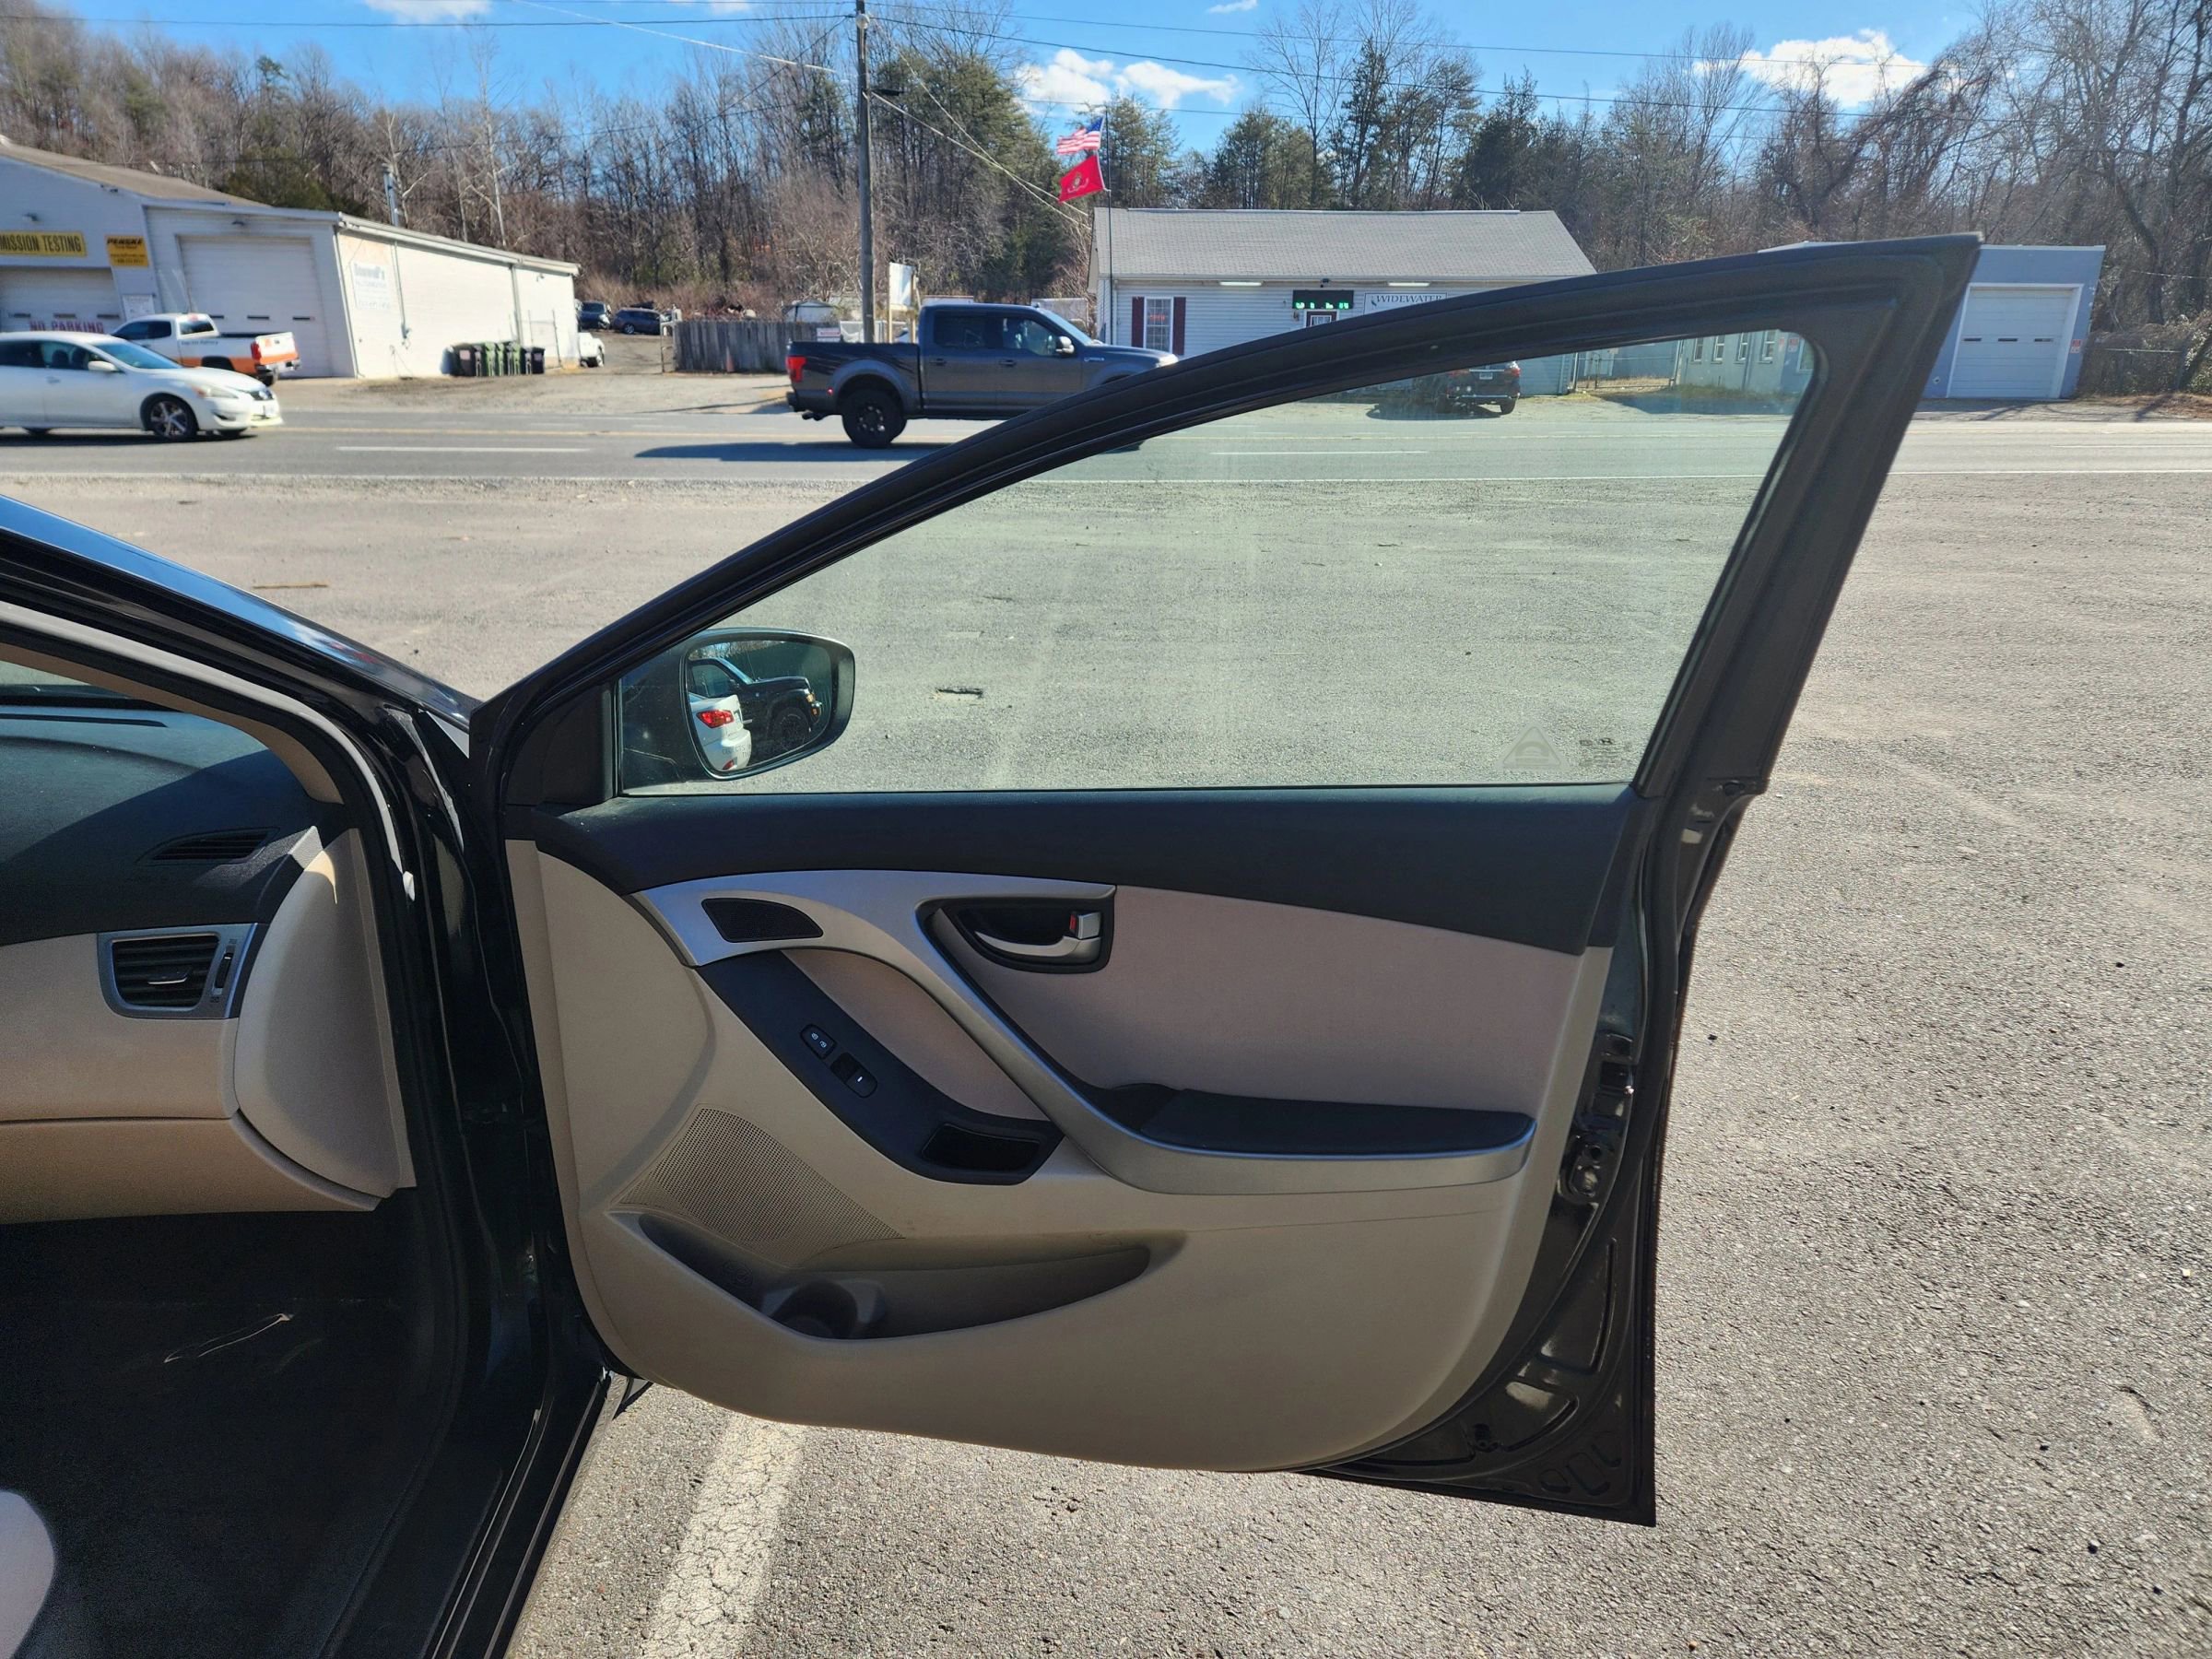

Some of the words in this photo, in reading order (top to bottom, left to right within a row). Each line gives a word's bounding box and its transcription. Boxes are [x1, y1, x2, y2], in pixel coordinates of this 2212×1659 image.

[41, 234, 82, 253] TESTING
[29, 320, 45, 332] NO
[52, 320, 104, 334] PARKING
